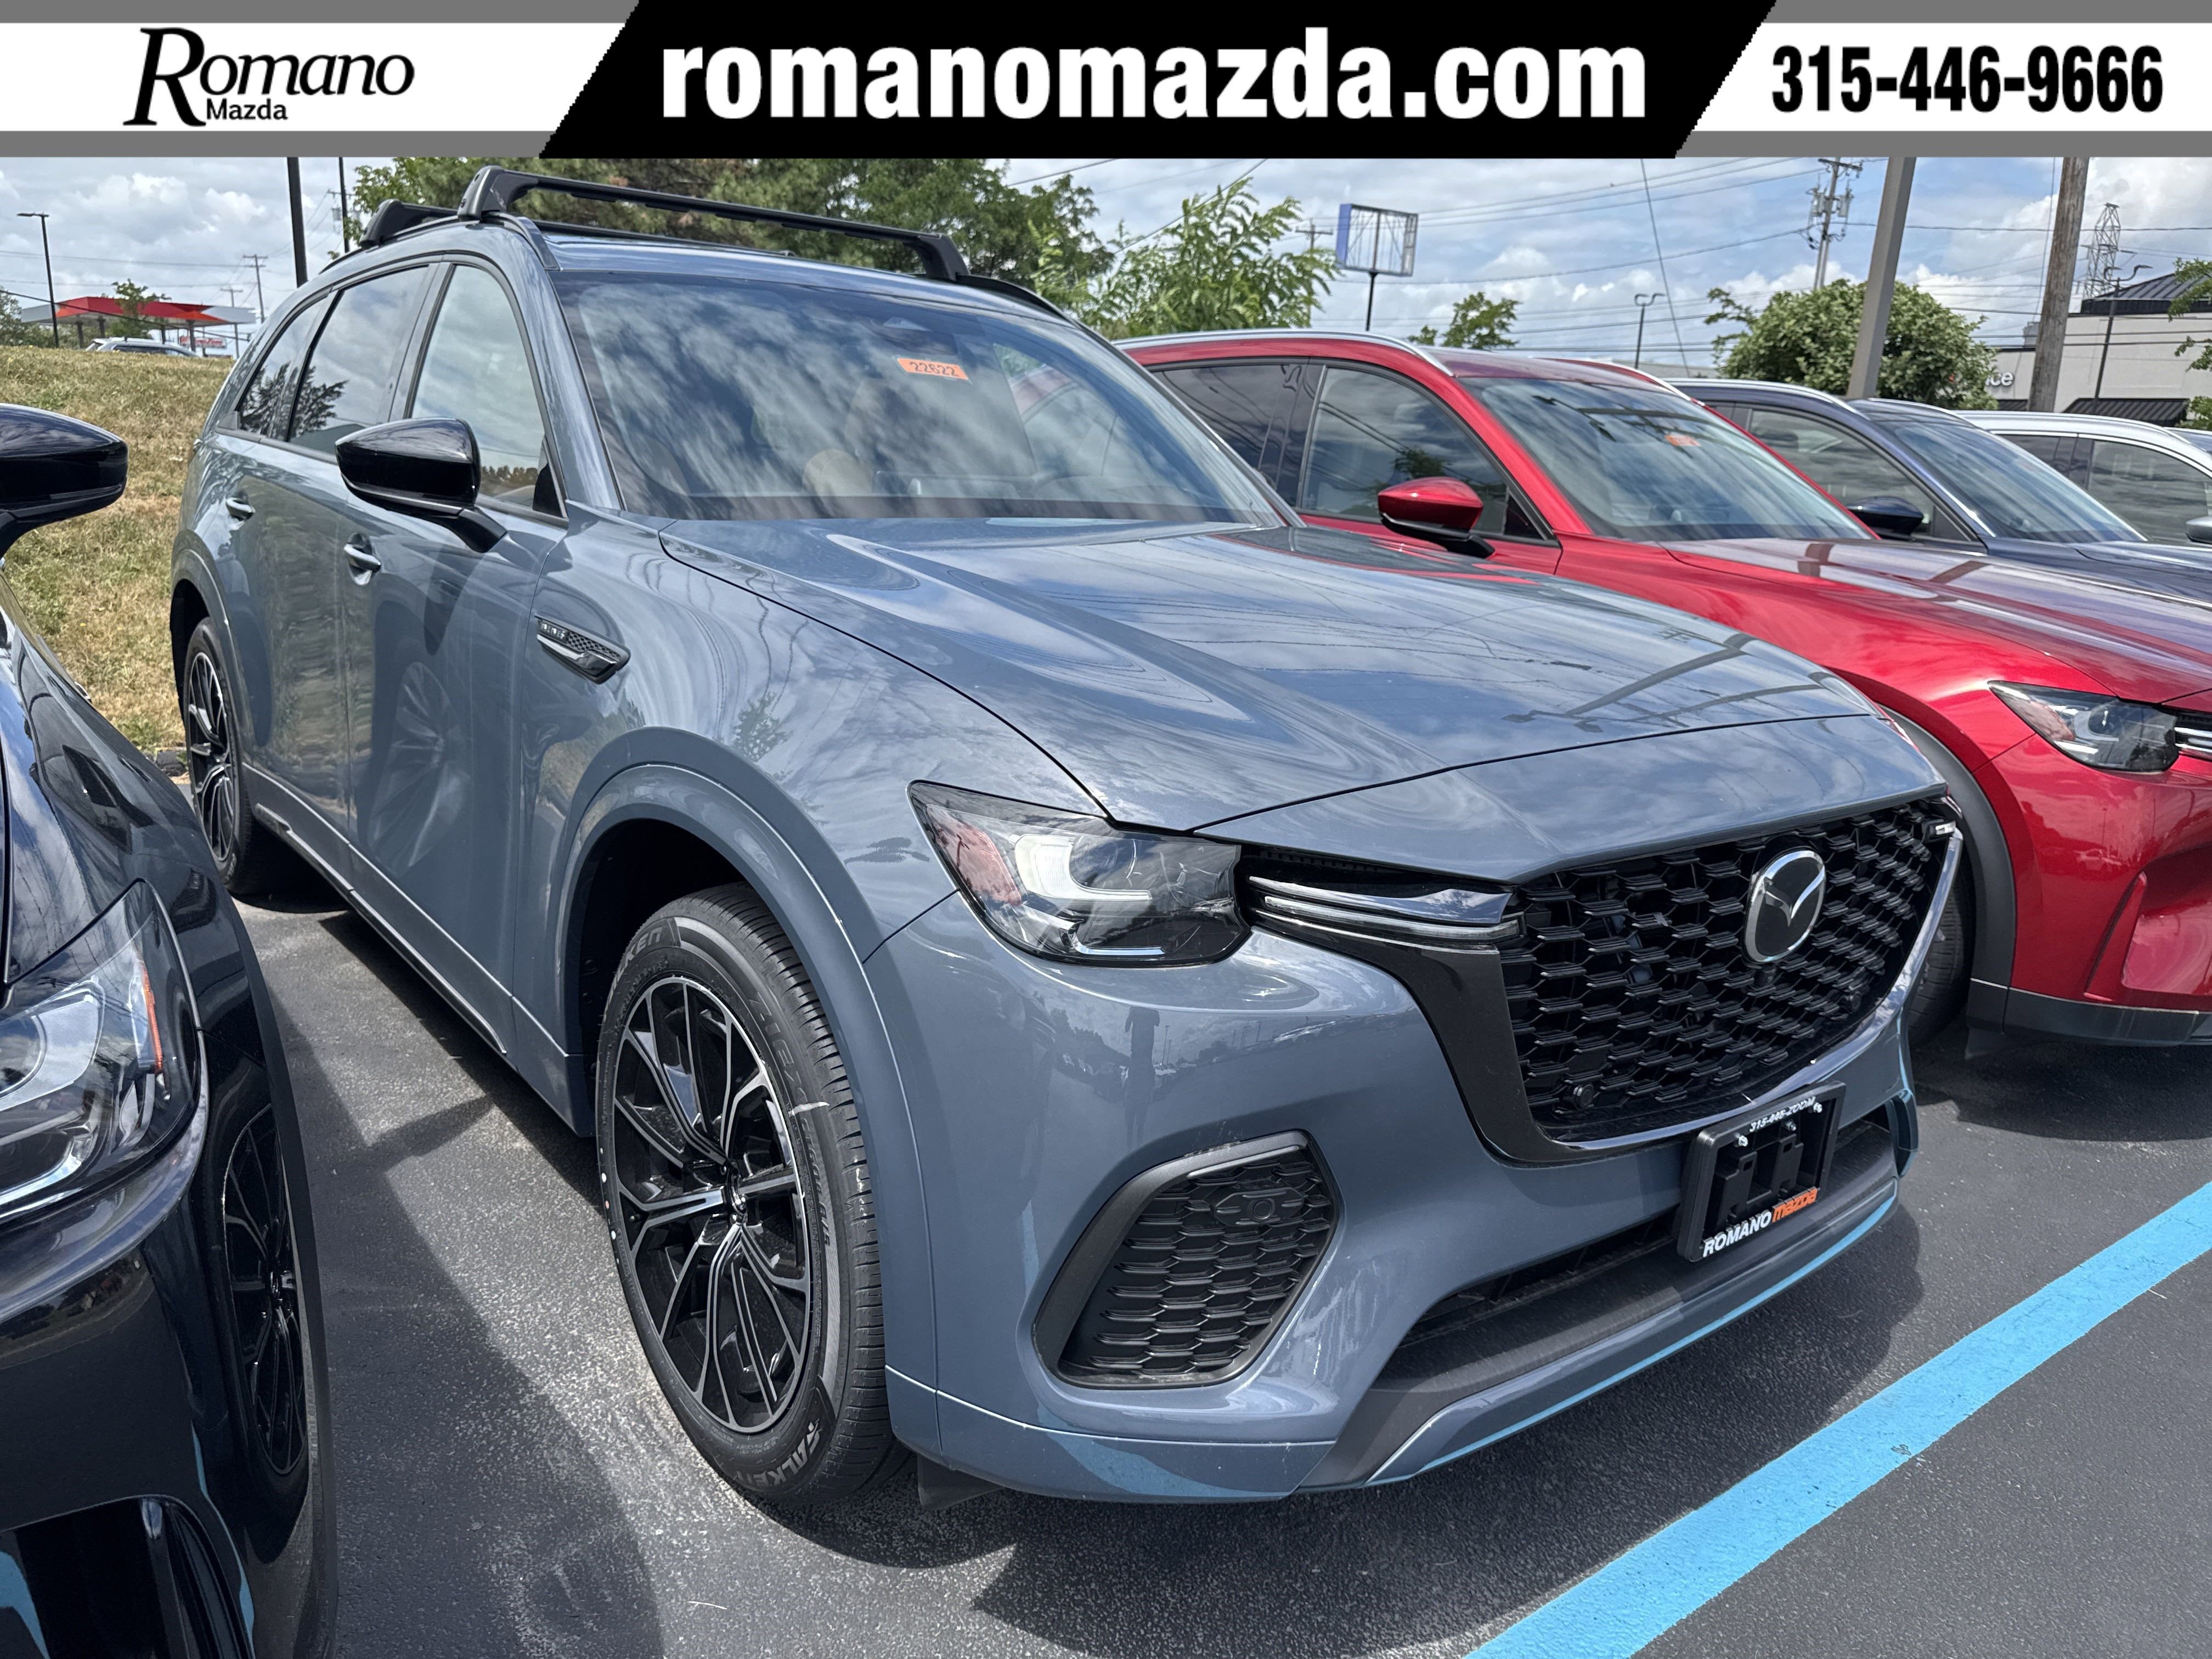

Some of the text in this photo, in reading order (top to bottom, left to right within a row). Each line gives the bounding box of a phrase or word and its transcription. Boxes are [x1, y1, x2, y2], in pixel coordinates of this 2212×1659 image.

[909, 361, 960, 377] 22622
[1702, 1210, 1772, 1257] ROMANO
[733, 1420, 822, 1488] FALKEN
